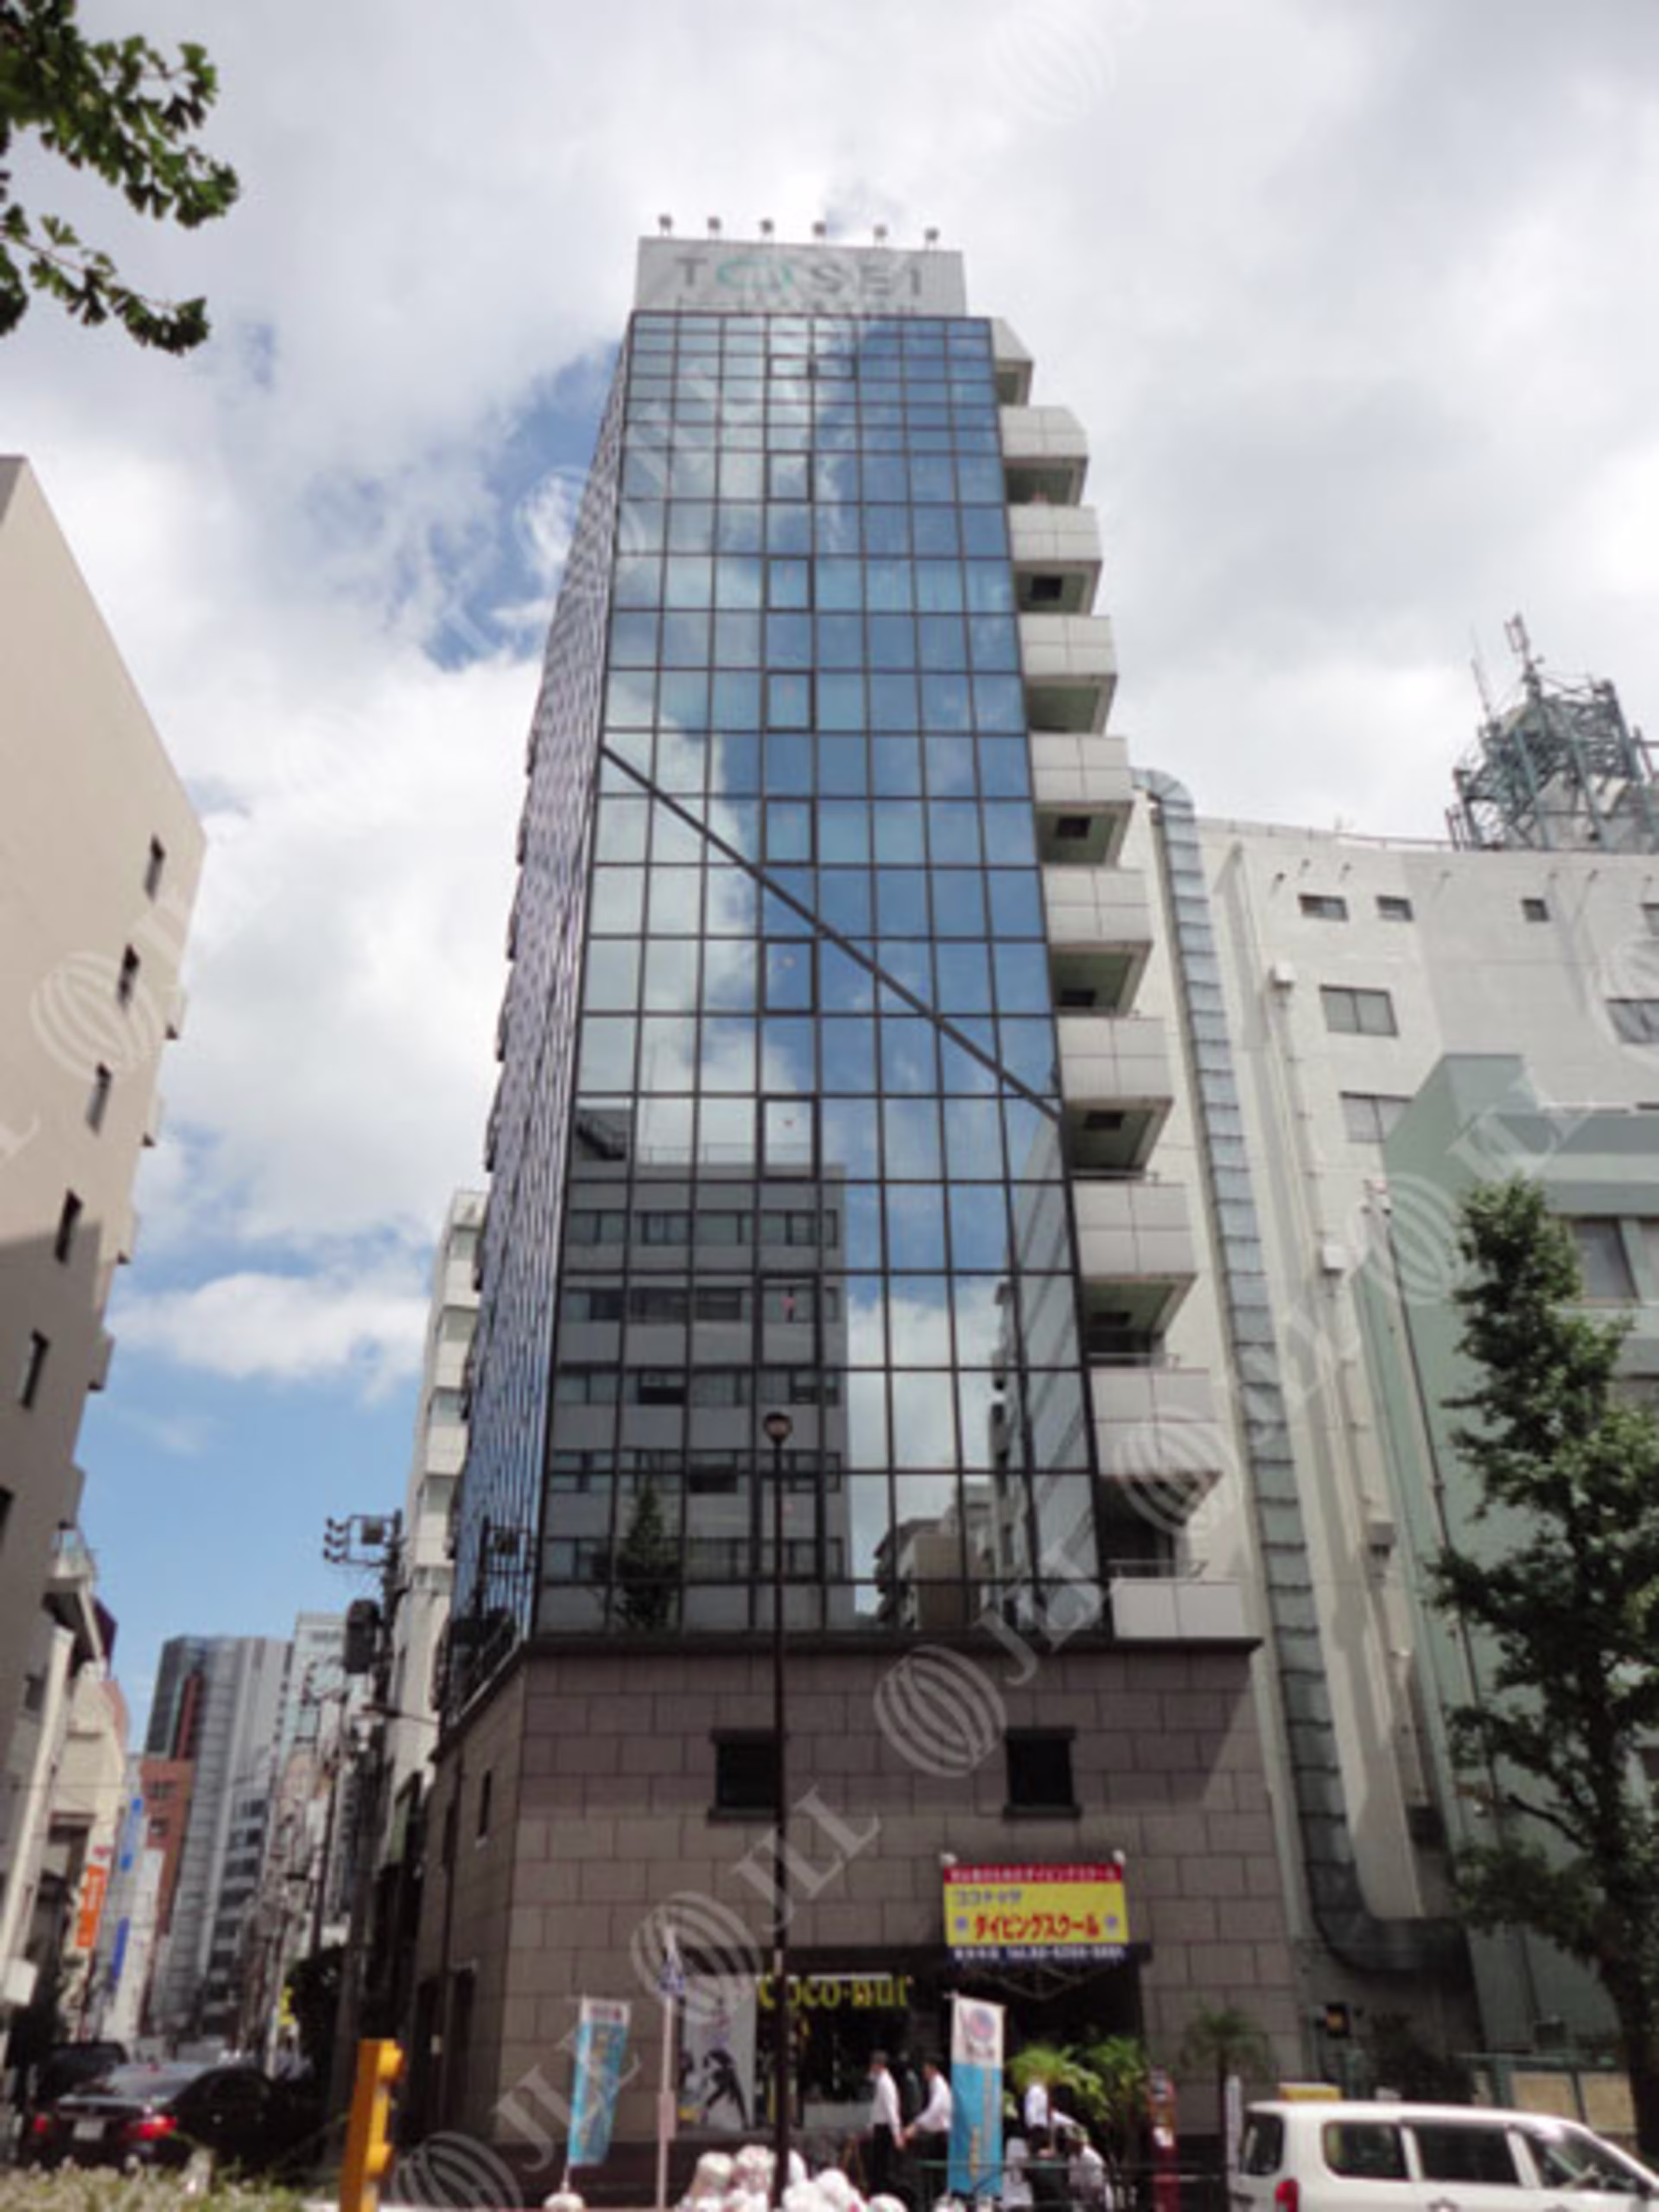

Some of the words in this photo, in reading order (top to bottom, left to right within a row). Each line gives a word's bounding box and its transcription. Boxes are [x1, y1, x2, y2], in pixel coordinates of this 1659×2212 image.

[974, 1914, 1100, 1940] ダイビングスクール
